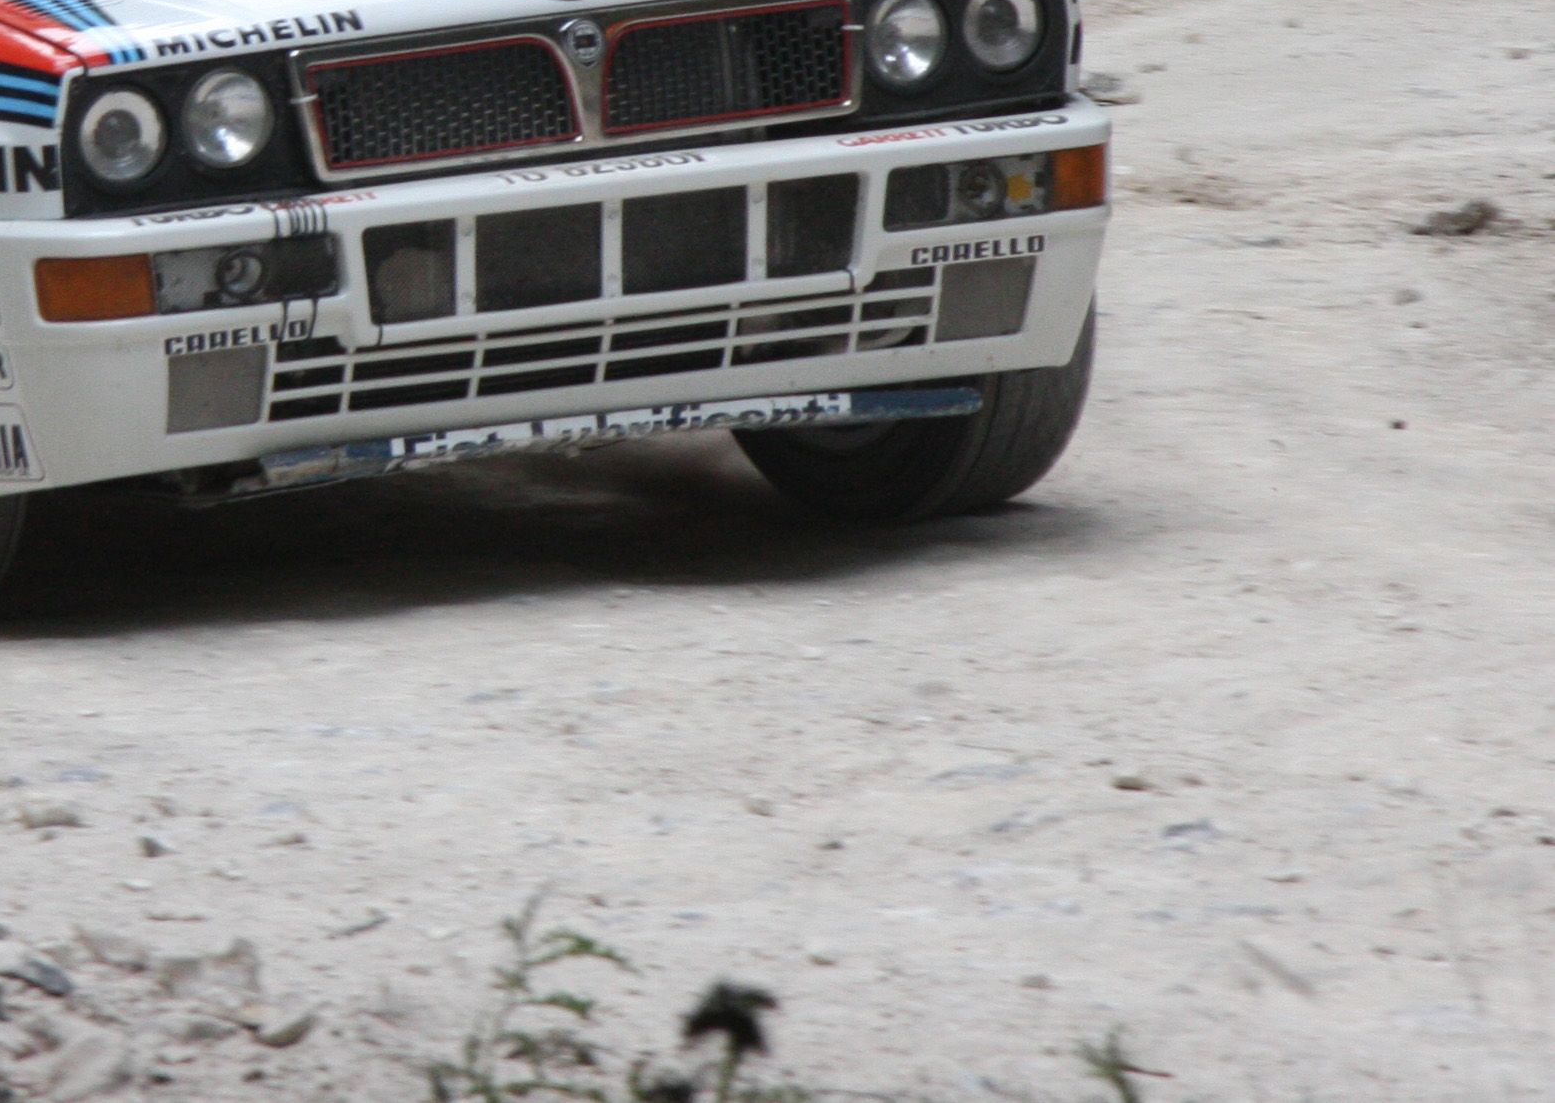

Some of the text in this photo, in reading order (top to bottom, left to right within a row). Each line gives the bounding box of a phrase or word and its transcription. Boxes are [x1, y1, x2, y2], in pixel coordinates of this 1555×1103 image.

[153, 8, 364, 57] MICHELIN
[951, 114, 1070, 135] TURBO
[910, 234, 1046, 266] CARELLO
[164, 319, 308, 356] CARELLO
